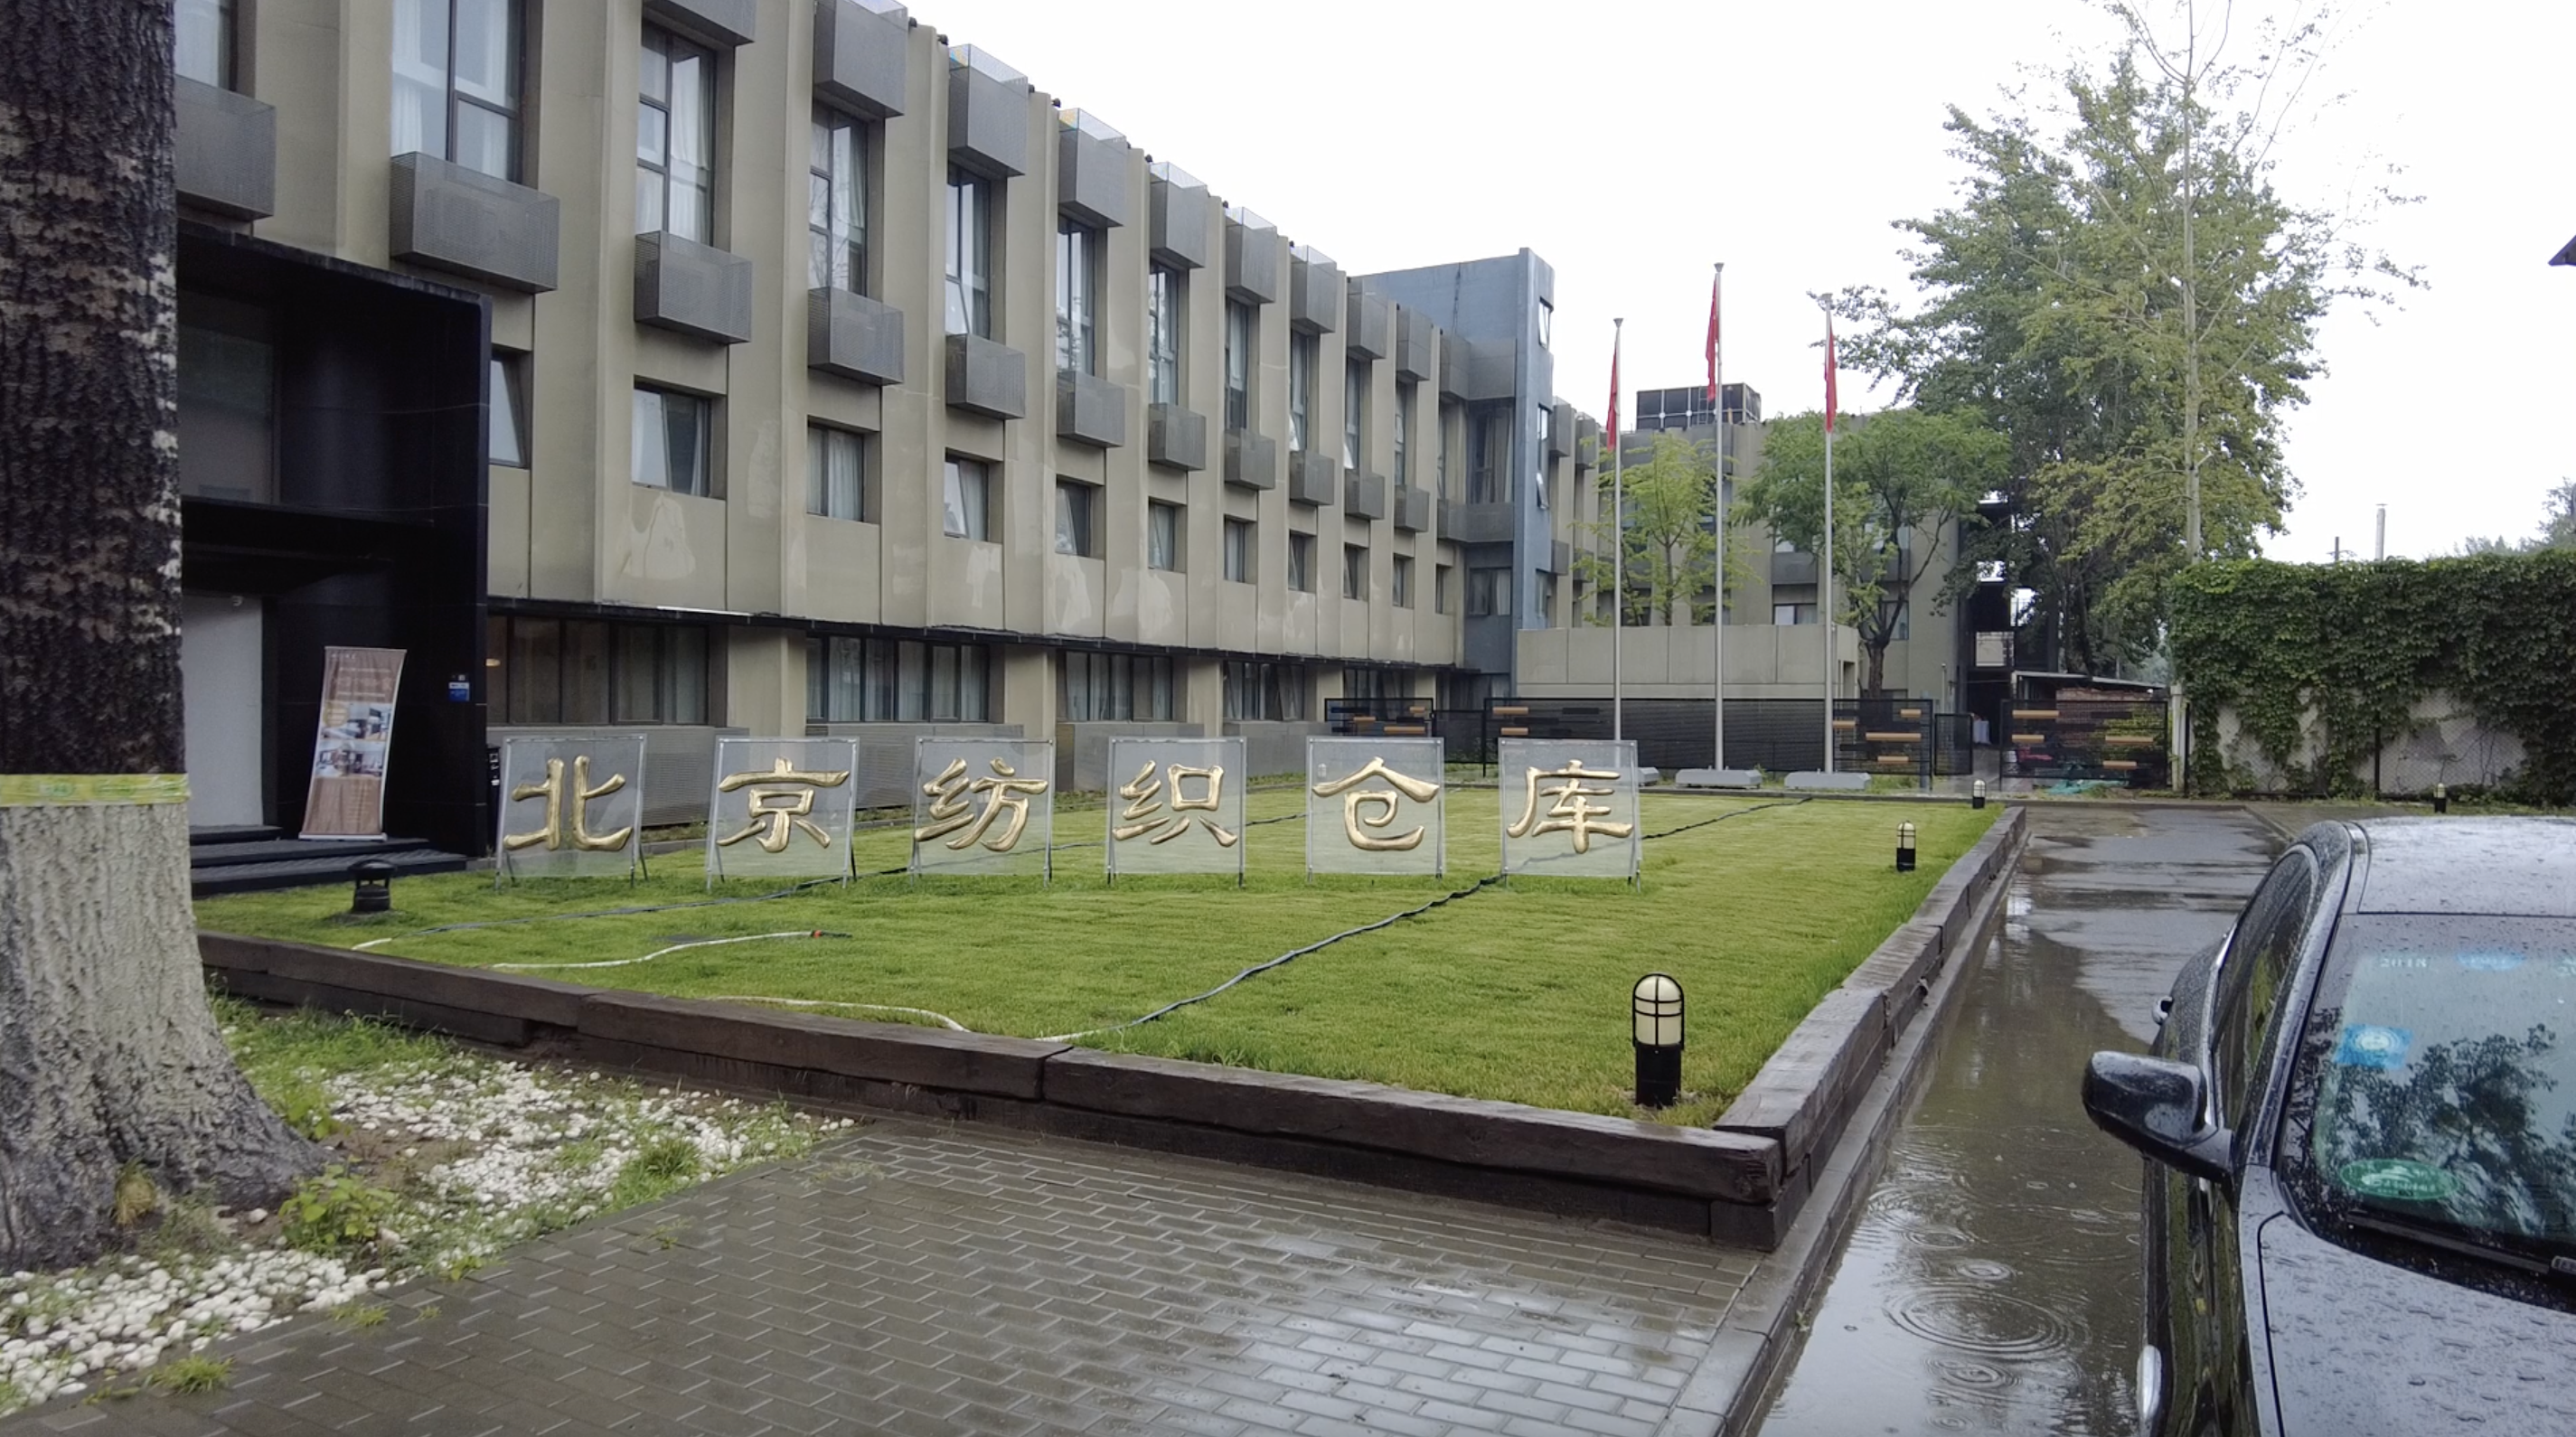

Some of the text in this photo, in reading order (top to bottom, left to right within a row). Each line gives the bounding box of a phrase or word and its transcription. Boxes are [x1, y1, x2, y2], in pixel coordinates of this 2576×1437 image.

[503, 755, 1634, 854] 北京纺织仓库
